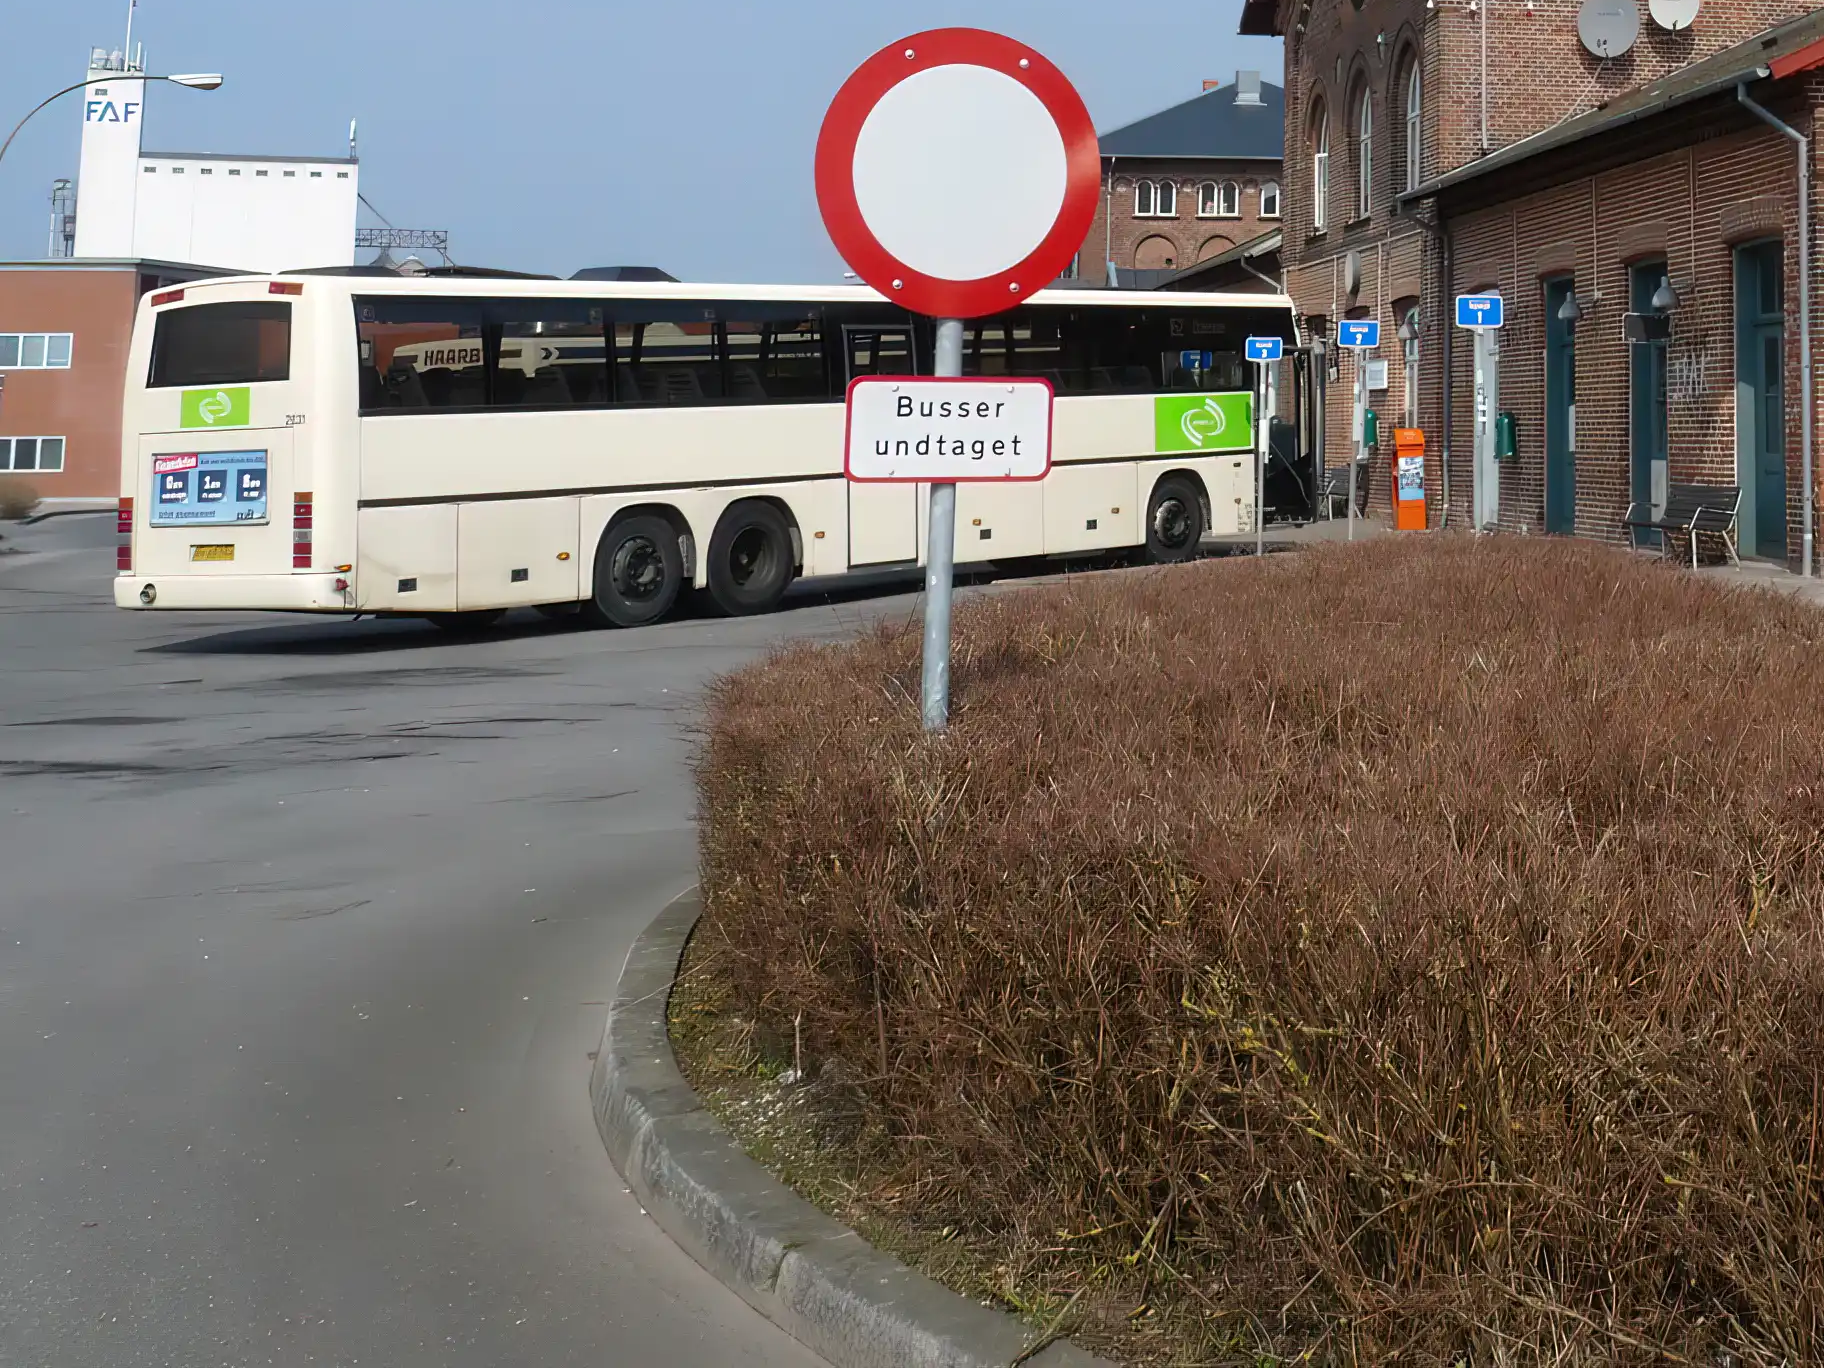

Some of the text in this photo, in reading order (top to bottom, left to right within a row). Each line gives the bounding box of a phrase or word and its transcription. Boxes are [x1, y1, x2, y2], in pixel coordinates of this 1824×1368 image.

[86, 101, 139, 122] FAF
[424, 348, 484, 366] HAARB
[896, 395, 1005, 418] Busser
[875, 434, 1022, 460] undtaget
